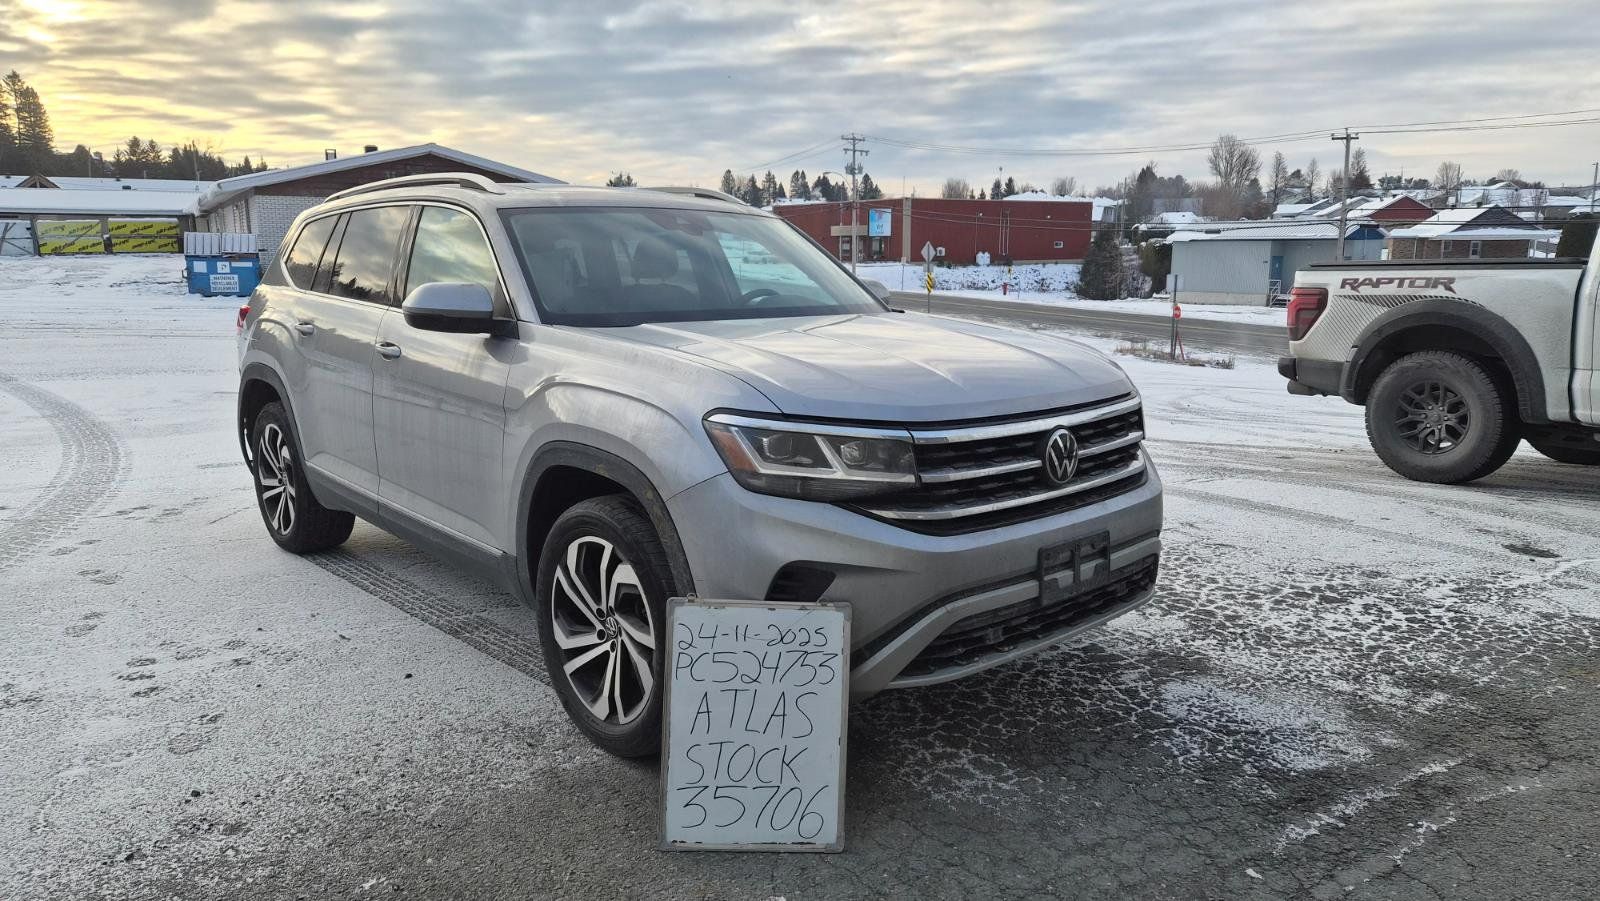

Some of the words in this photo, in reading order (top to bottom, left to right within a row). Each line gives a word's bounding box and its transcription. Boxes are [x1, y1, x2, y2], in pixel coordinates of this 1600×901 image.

[1340, 277, 1457, 294] RAPTOR
[678, 623, 828, 649] 24-11-2025
[675, 651, 838, 686] PC524753
[690, 688, 818, 739] ATLAS
[686, 741, 808, 784] STOCK
[676, 785, 829, 839] 35706
